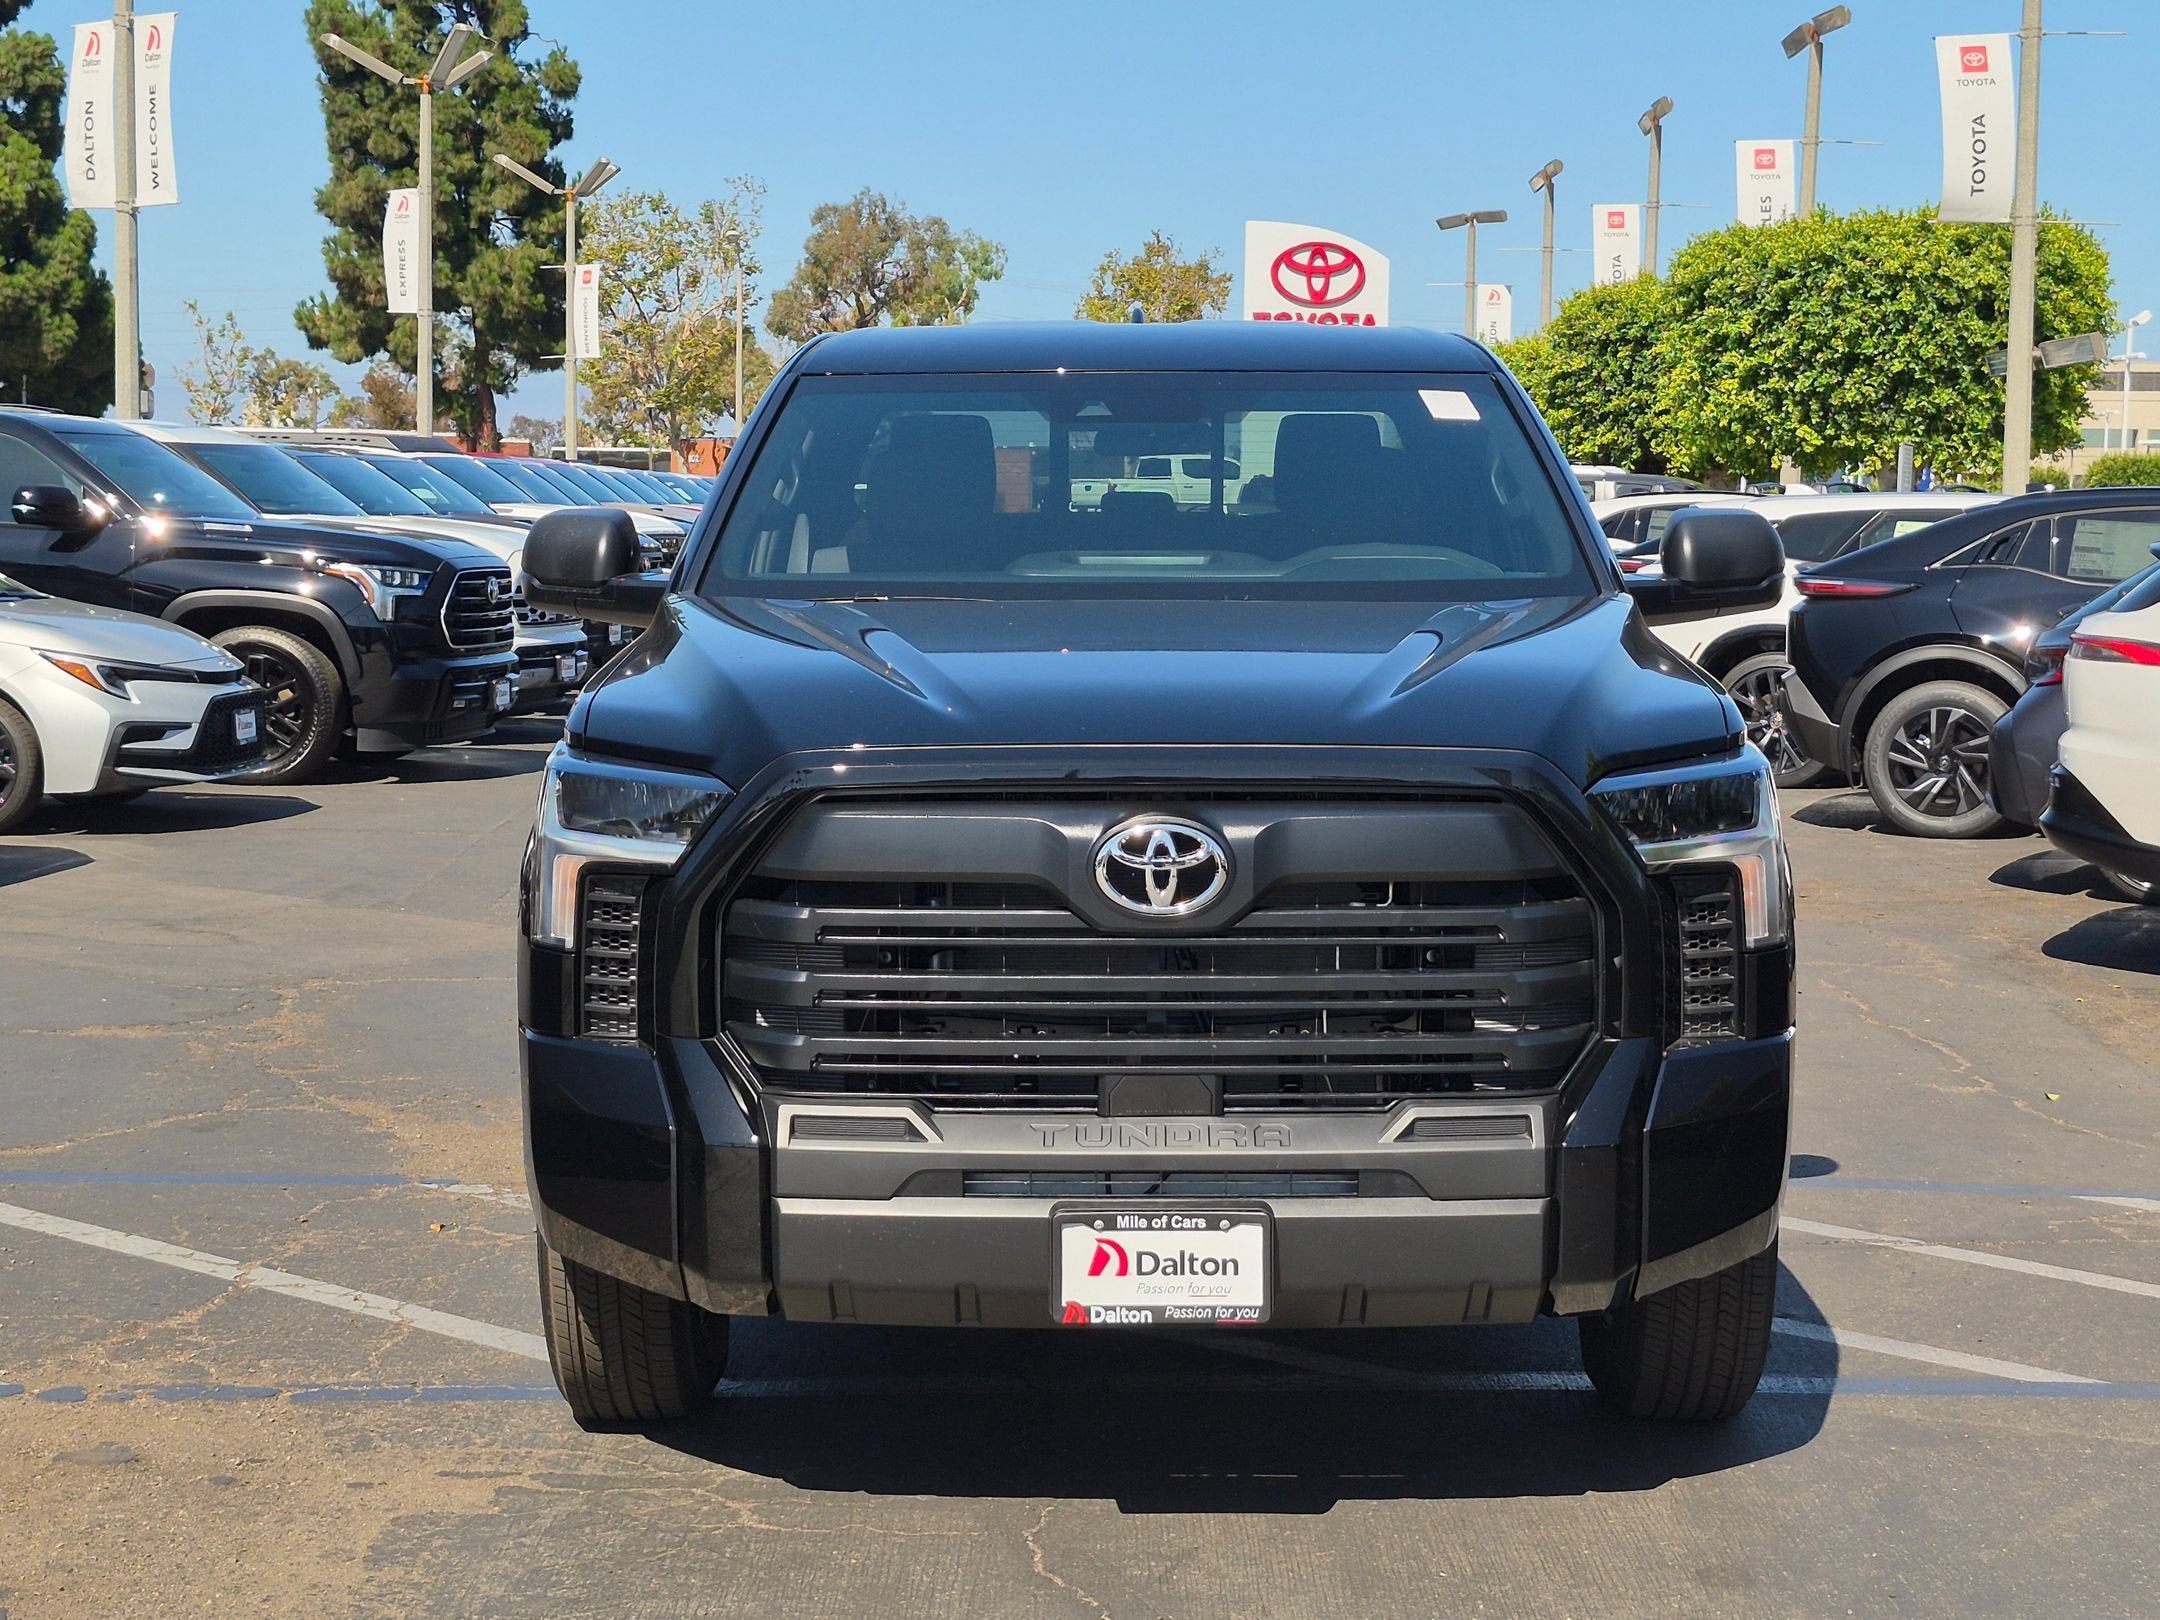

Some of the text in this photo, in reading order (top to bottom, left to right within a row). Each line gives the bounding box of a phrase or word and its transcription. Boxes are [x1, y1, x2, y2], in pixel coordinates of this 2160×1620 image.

[1957, 78, 1996, 87] TOYOTA
[84, 101, 96, 181] DALTON
[150, 84, 160, 190] WELCOME
[1970, 114, 1986, 197] TOYOTA
[398, 239, 407, 297] EXPRESS
[1029, 1122, 1292, 1148] TUNDRA
[1116, 1214, 1207, 1229] Mile of Cars
[1136, 1250, 1239, 1276] Dalton
[1136, 1282, 1232, 1297] Passion for you
[1090, 1305, 1260, 1323] Dalton Passion for you
